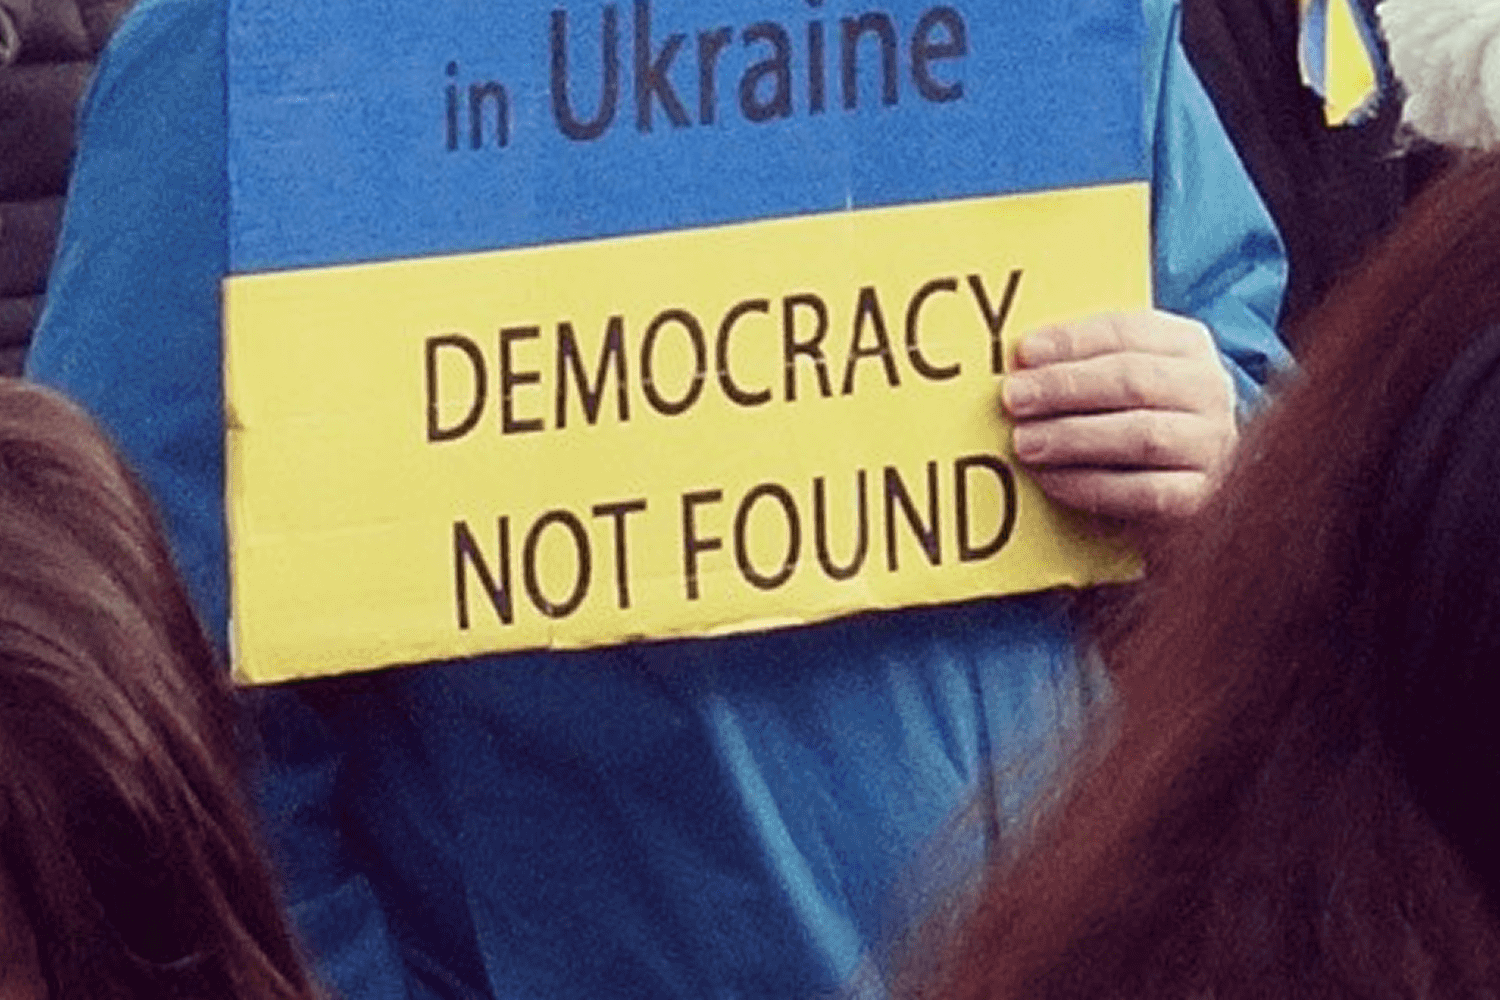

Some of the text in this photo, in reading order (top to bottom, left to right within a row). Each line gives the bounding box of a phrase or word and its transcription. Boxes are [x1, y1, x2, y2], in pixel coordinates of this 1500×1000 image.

[444, 61, 510, 152] in
[425, 270, 1023, 443] DEMOCRACY
[452, 452, 1019, 630] NOT FOUND
